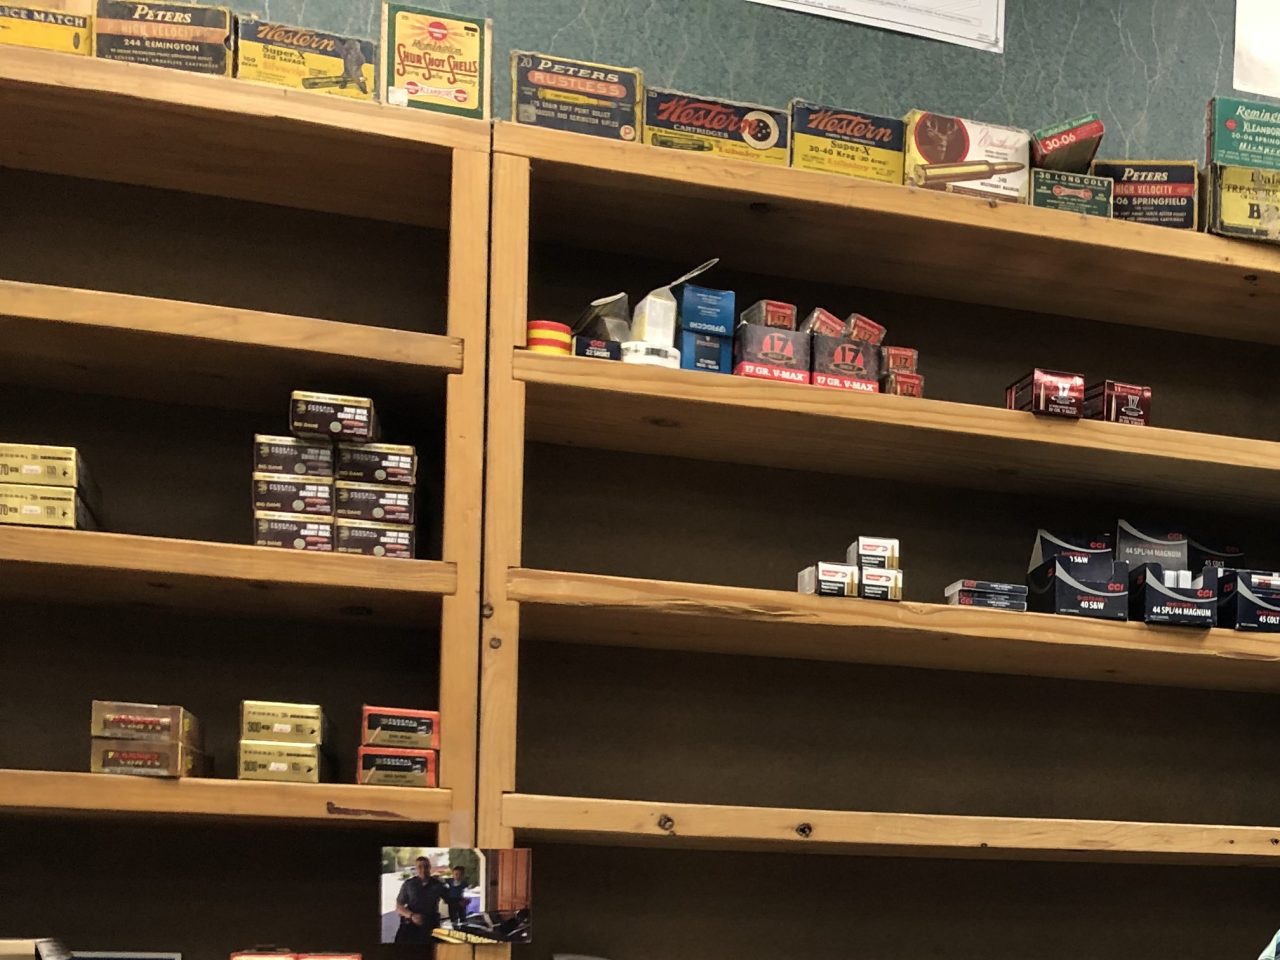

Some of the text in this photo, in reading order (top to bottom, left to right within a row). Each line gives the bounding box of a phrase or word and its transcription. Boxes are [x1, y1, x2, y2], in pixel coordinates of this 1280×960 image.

[33, 11, 85, 28] MATCH
[133, 4, 192, 24] PETERS
[123, 38, 200, 52] 244 REMINGTON
[256, 22, 336, 52] Western
[397, 43, 422, 77] SHUR
[537, 59, 619, 83] PETERS
[535, 72, 621, 97] RUSTLESS
[656, 98, 759, 136] Western
[807, 109, 893, 142] Western
[673, 123, 729, 139] CARTRIDGES
[830, 139, 871, 156] Super-X
[1045, 133, 1076, 150] 30-06
[808, 144, 856, 162] 30-40 Krag
[1055, 174, 1109, 188] LONG COLT
[1121, 167, 1169, 182] PETERS
[1115, 183, 1173, 194] HIGH VELOCITY
[1131, 197, 1188, 206] SPRINGFIELD
[766, 333, 789, 355] 17
[841, 344, 861, 365] 17
[744, 364, 804, 381] 17 GR. V-MAX
[816, 375, 874, 392] 17 GR. V-MAX
[1090, 541, 1106, 549] CCI
[1108, 583, 1124, 592] CCI
[1197, 589, 1213, 598] CCI
[1080, 600, 1104, 610] 40 S&W
[1152, 605, 1212, 616] 44 SPL/44 MAGNUM
[1259, 615, 1280, 624] 45 COLT
